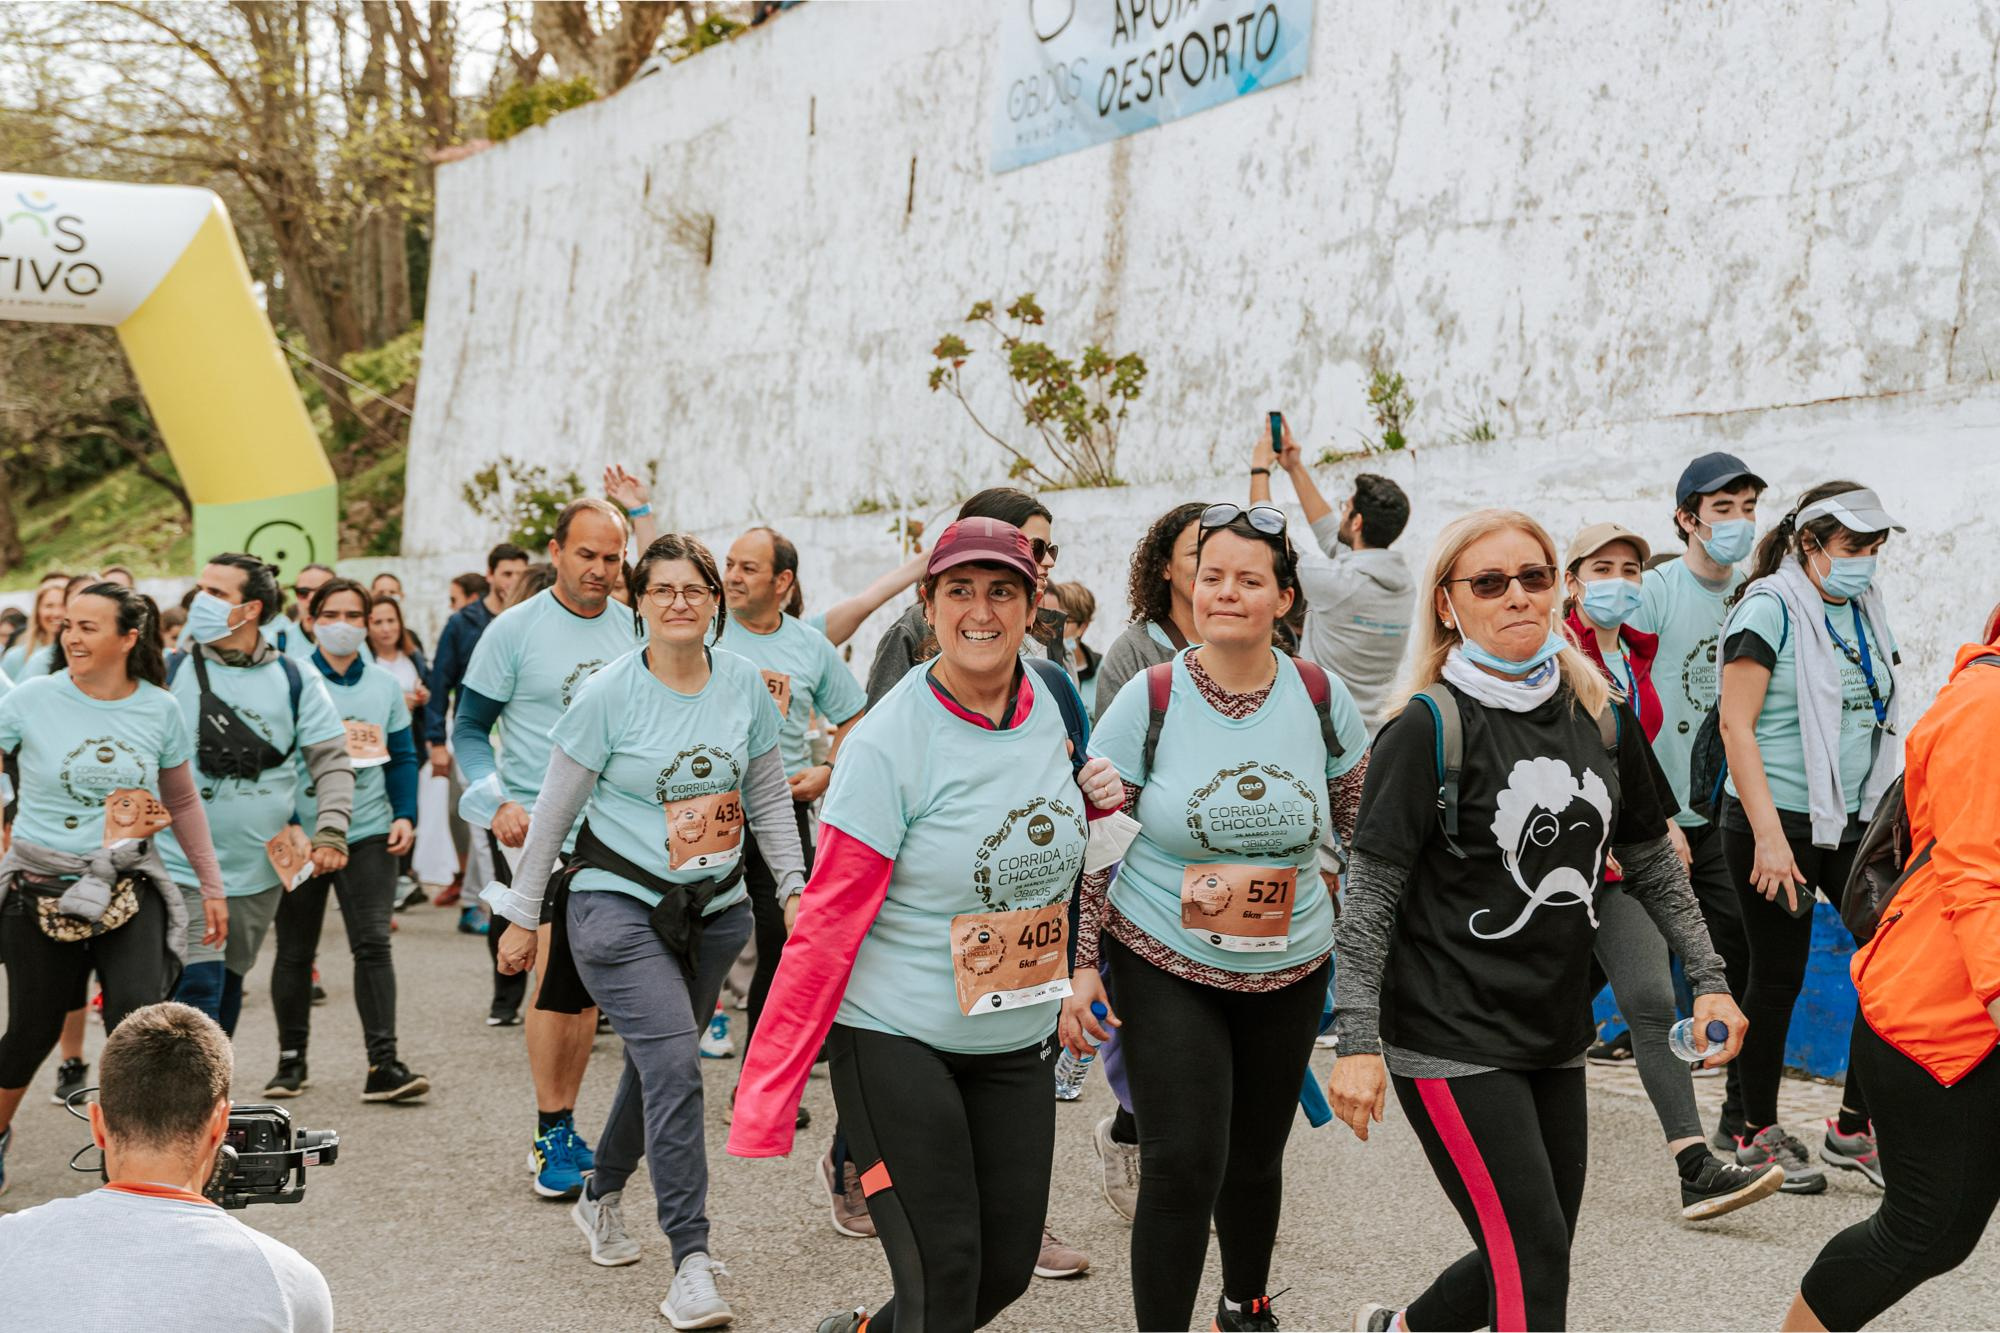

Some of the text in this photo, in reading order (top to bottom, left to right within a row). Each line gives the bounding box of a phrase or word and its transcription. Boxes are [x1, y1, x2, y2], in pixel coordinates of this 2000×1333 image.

[1097, 3, 1279, 118] DESPORTO
[350, 729, 378, 743] 335
[671, 780, 716, 793] CORRIDA
[1208, 800, 1304, 819] CORRIDA DO
[1210, 814, 1307, 832] CHOCOLATE
[998, 840, 1080, 872] CORRIDA DO
[998, 856, 1078, 886] CHOCOLATE
[1247, 880, 1289, 904] 521
[1242, 910, 1262, 919] 6km
[1018, 917, 1063, 950] 403
[1019, 959, 1037, 969] 6km
